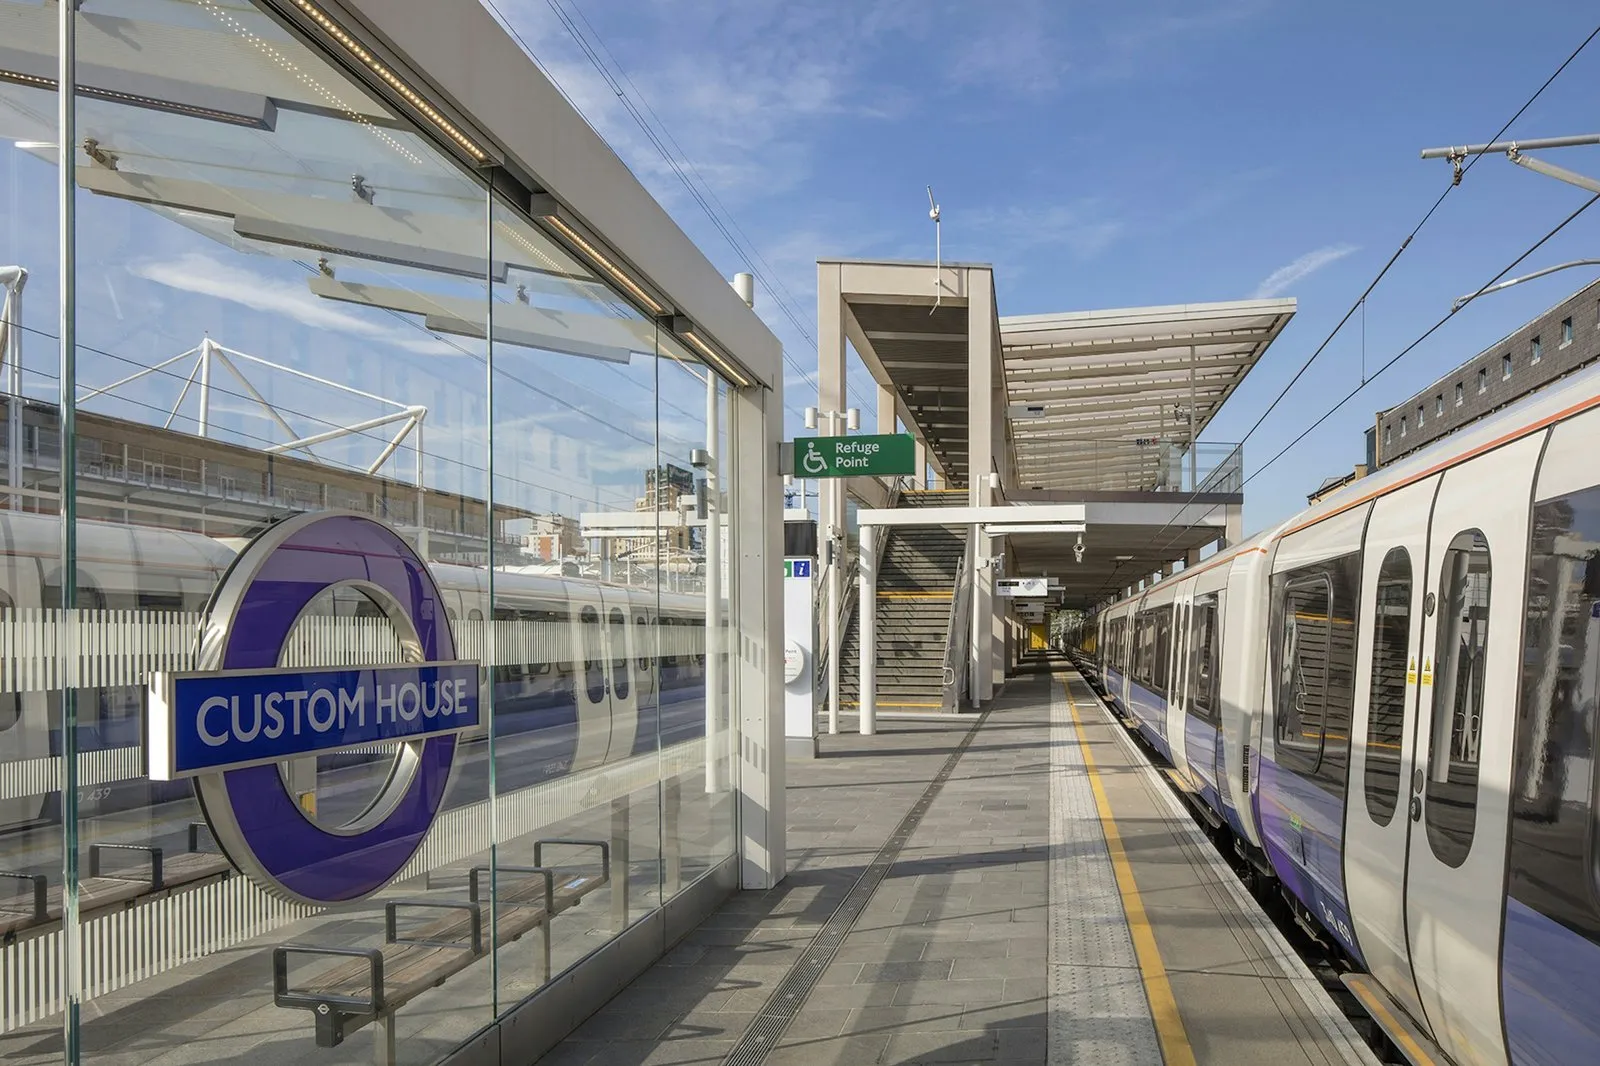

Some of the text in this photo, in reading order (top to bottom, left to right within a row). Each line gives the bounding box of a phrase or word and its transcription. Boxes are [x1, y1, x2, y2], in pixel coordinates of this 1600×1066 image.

[835, 441, 880, 455] Refuge
[835, 456, 869, 468] Point
[196, 679, 468, 747] CUSTOM HOUSE
